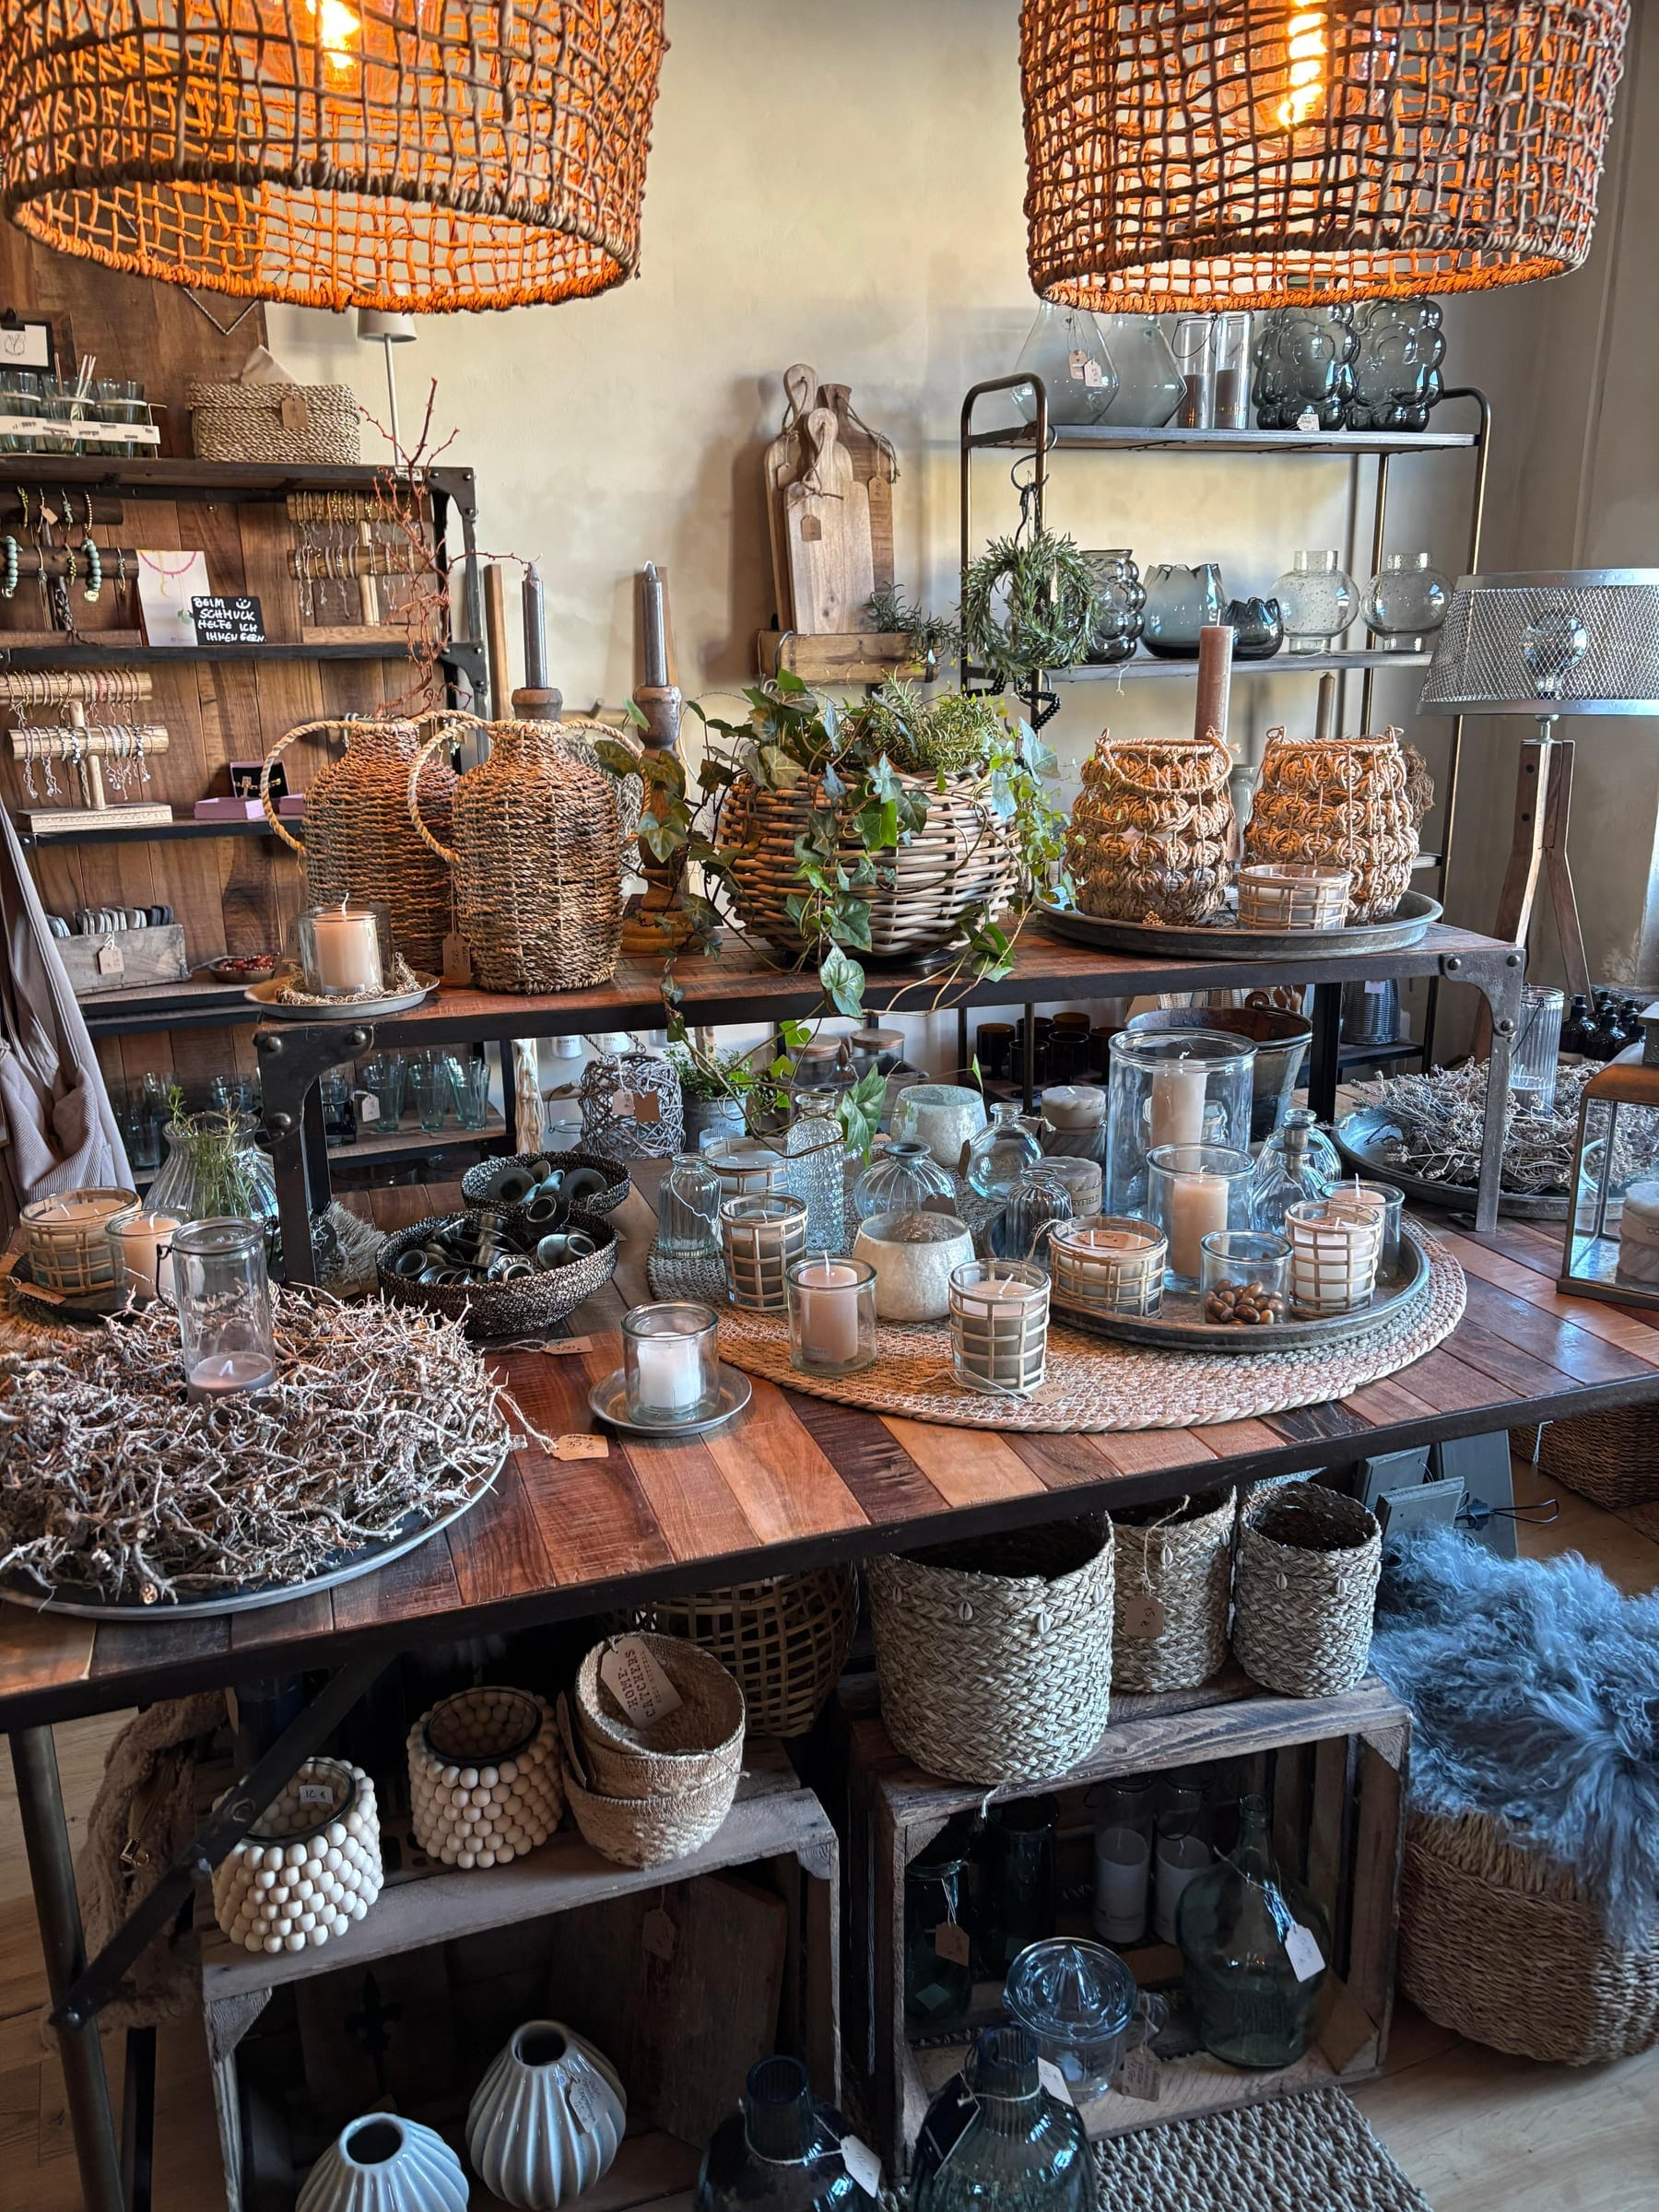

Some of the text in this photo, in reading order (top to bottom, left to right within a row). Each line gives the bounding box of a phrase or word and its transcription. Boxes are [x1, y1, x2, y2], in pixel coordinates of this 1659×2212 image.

[193, 597, 226, 608] BEIM
[199, 609, 256, 621] SCHMUCK
[197, 620, 258, 632] HELFE ICH
[206, 631, 238, 642] IHNEN
[625, 1649, 656, 1718] CATCHERS
[305, 1789, 316, 1798] 12
